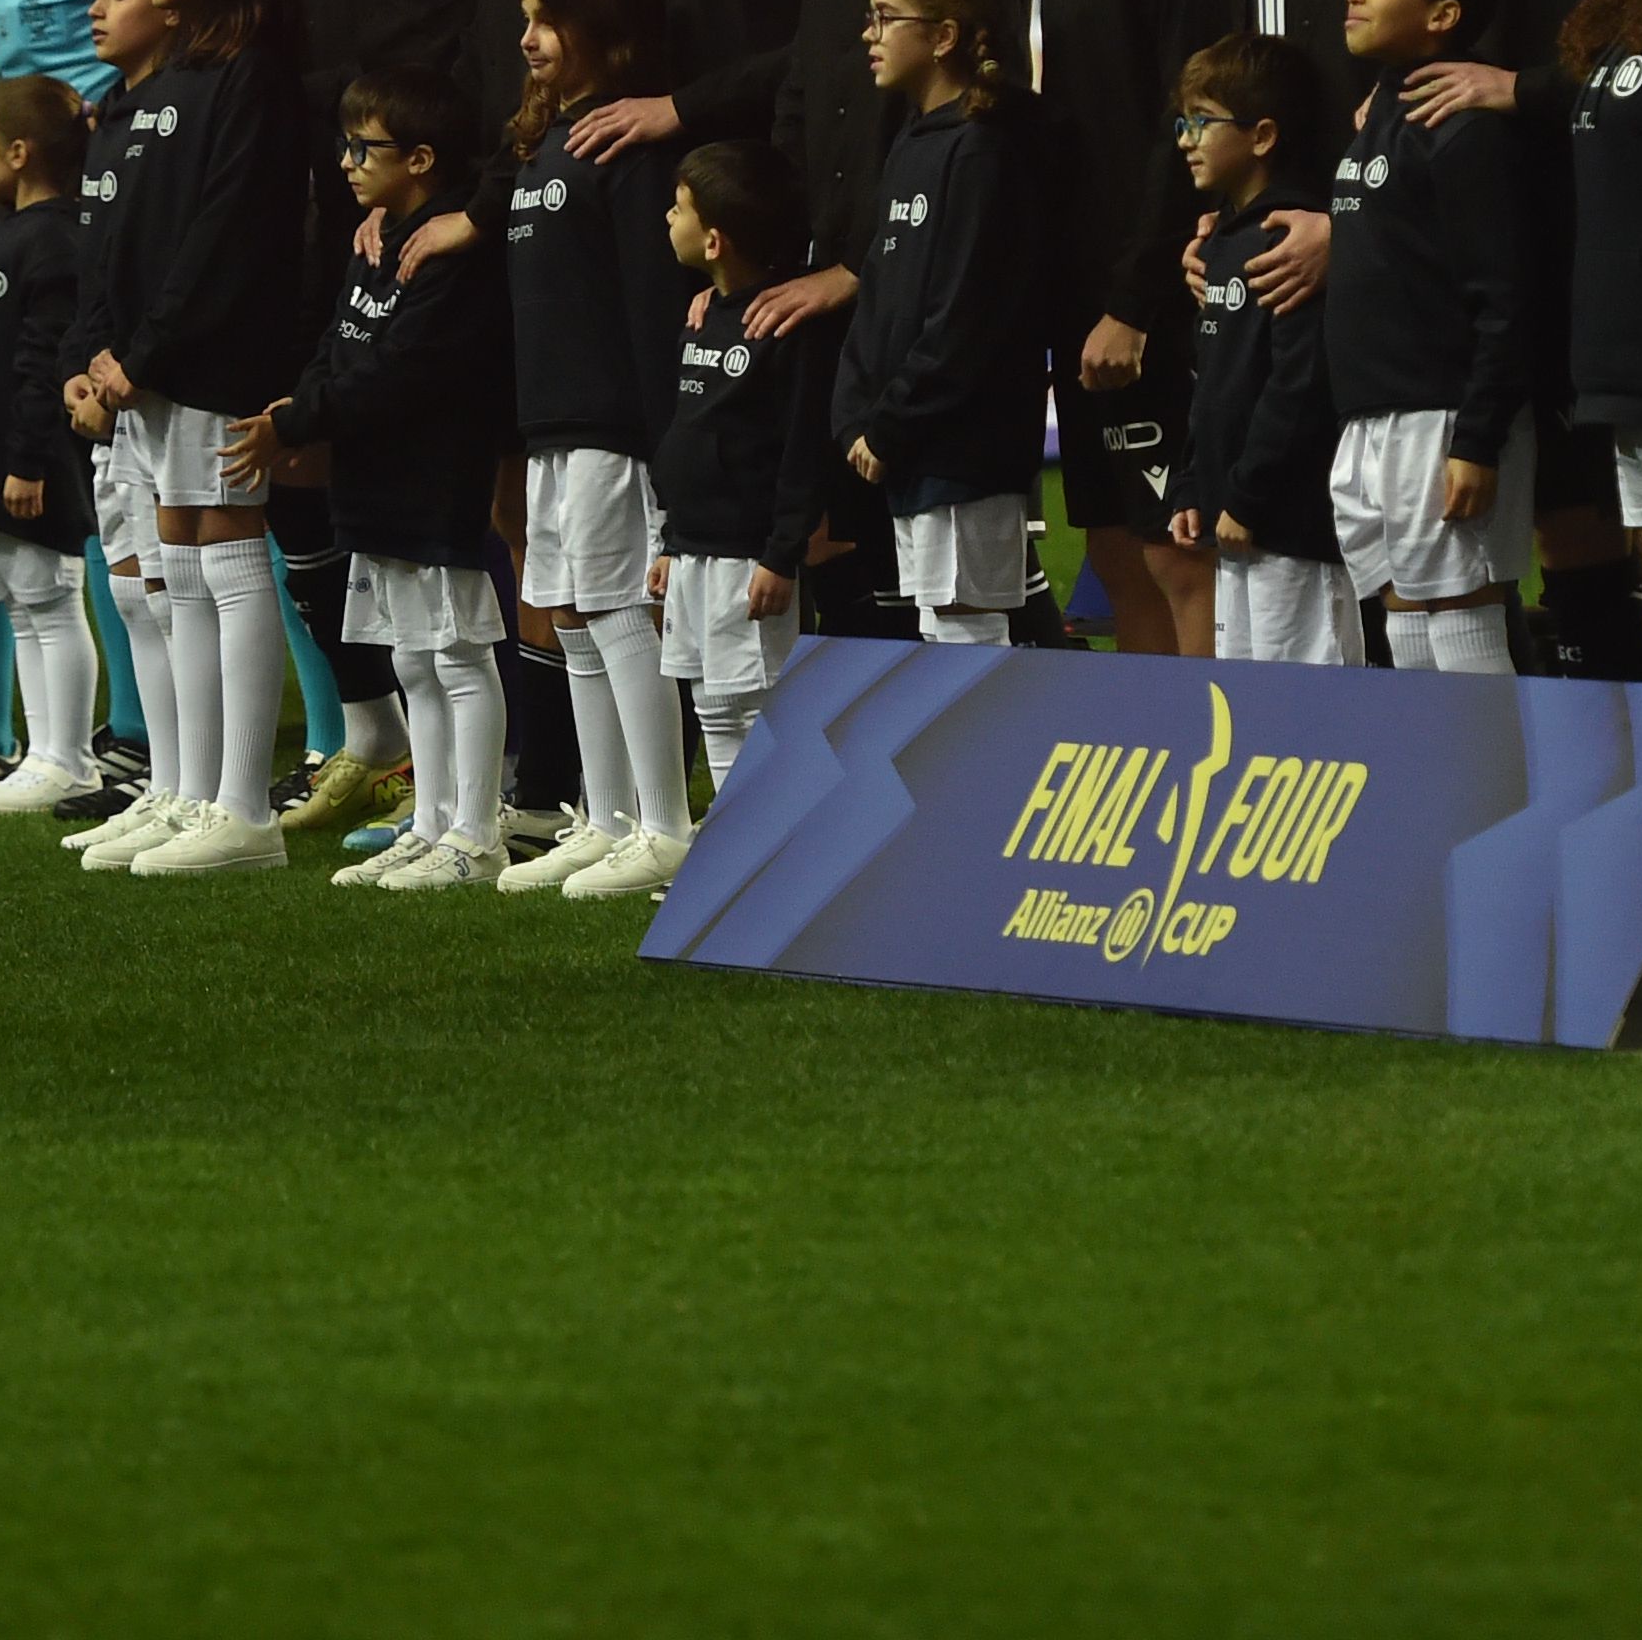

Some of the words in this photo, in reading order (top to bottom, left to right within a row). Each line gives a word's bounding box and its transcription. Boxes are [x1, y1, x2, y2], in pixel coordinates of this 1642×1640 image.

[507, 222, 534, 243] eguros
[1002, 742, 1170, 868] FINAL
[1197, 755, 1370, 884] FOUR
[1002, 888, 1112, 945] Allianz
[1161, 900, 1238, 957] CUP
